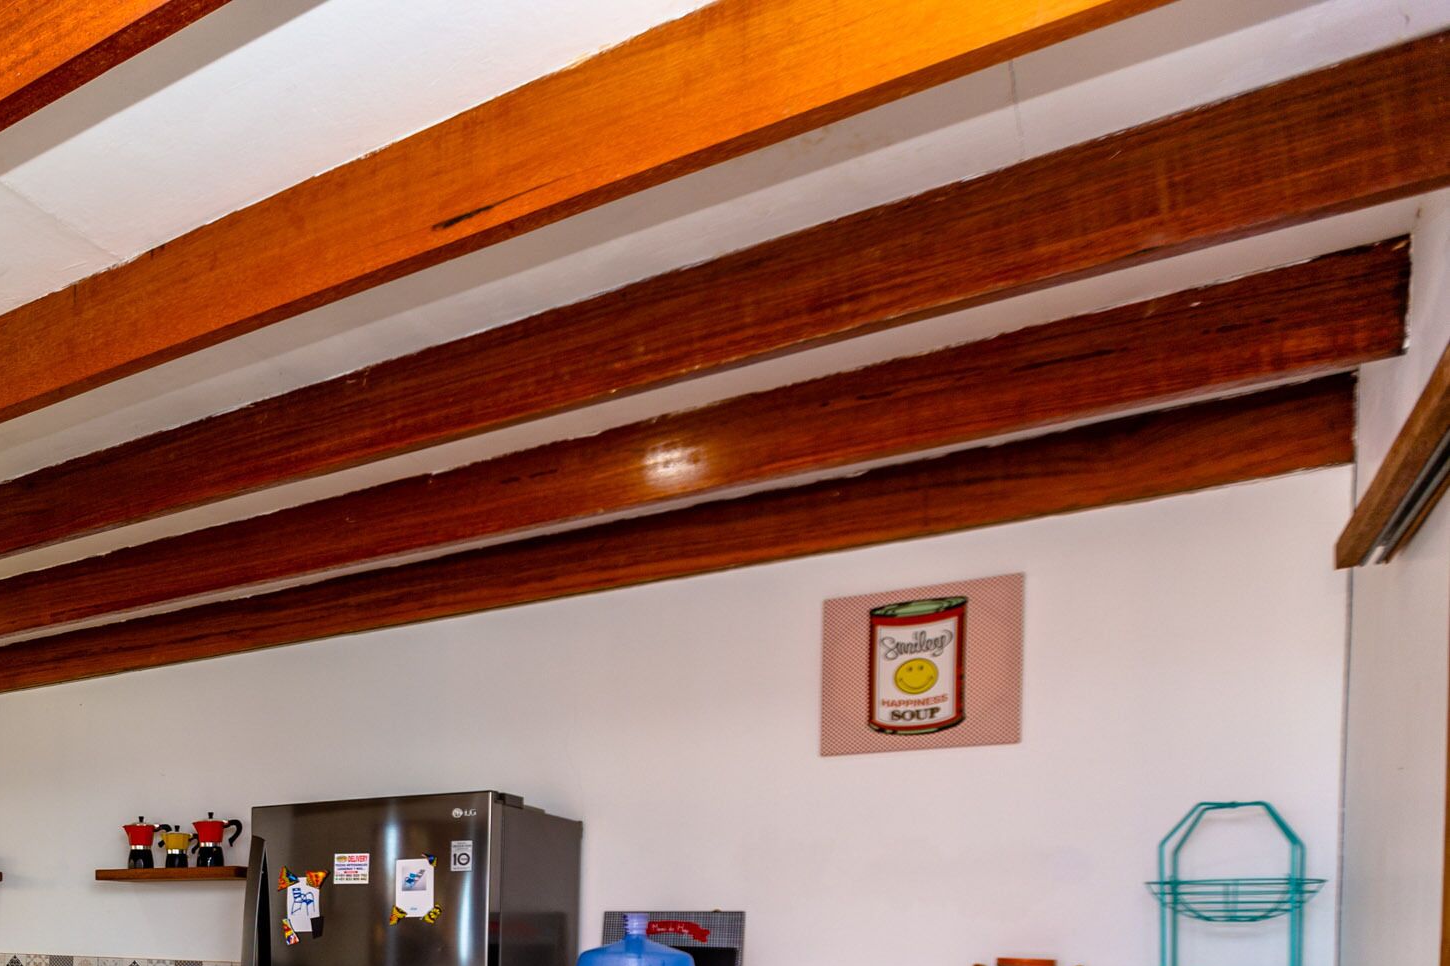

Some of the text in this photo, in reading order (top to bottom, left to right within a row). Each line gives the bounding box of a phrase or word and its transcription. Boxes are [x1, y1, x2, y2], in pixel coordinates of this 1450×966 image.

[881, 629, 953, 660] Smiley
[881, 693, 949, 707] HAPPINESS
[891, 706, 941, 721] SOUP
[453, 852, 470, 866] 10
